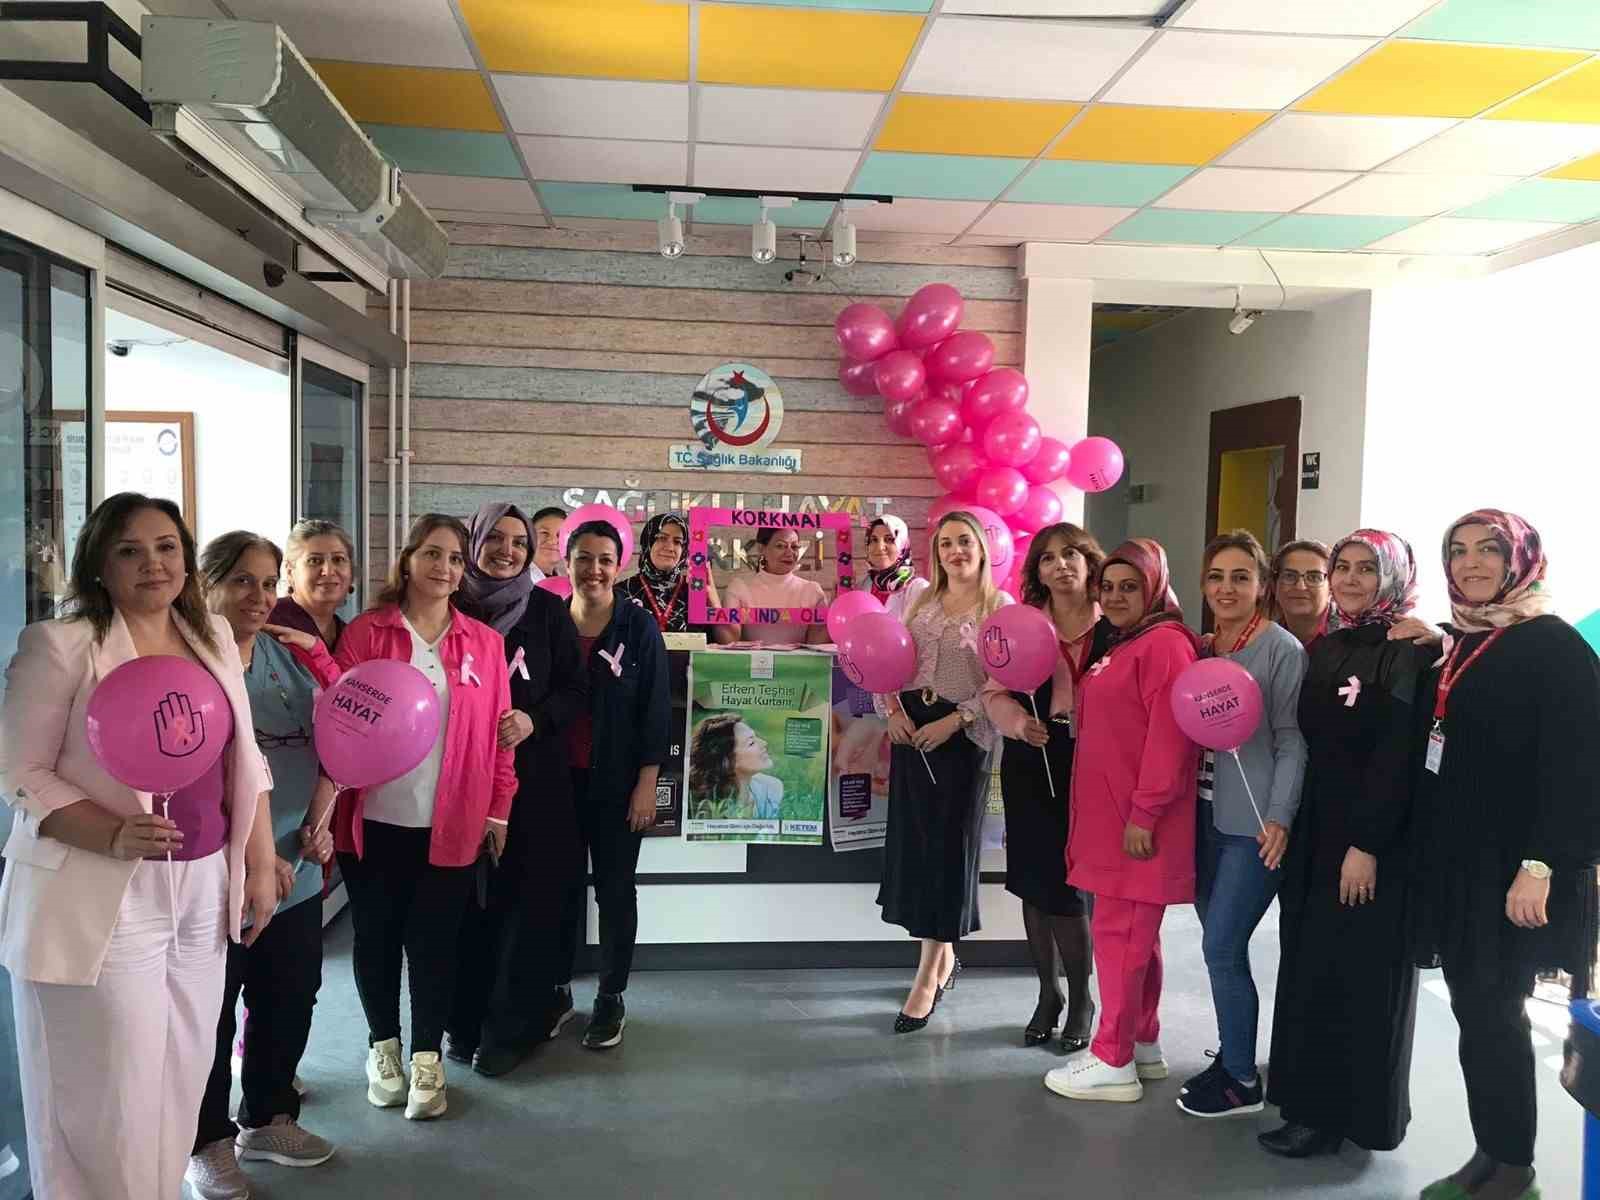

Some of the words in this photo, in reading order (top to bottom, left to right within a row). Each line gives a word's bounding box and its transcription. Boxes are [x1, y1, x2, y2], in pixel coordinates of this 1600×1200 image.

[696, 451, 736, 467] Sağlık
[739, 454, 797, 470] Bakanlığı
[1305, 454, 1319, 465] WC
[706, 607, 793, 624] FARKINDA
[800, 607, 825, 623] OL
[721, 683, 756, 695] Erken
[331, 693, 382, 725] HAYAT
[721, 695, 753, 706] Hayat
[1199, 696, 1241, 719] HAYAT
